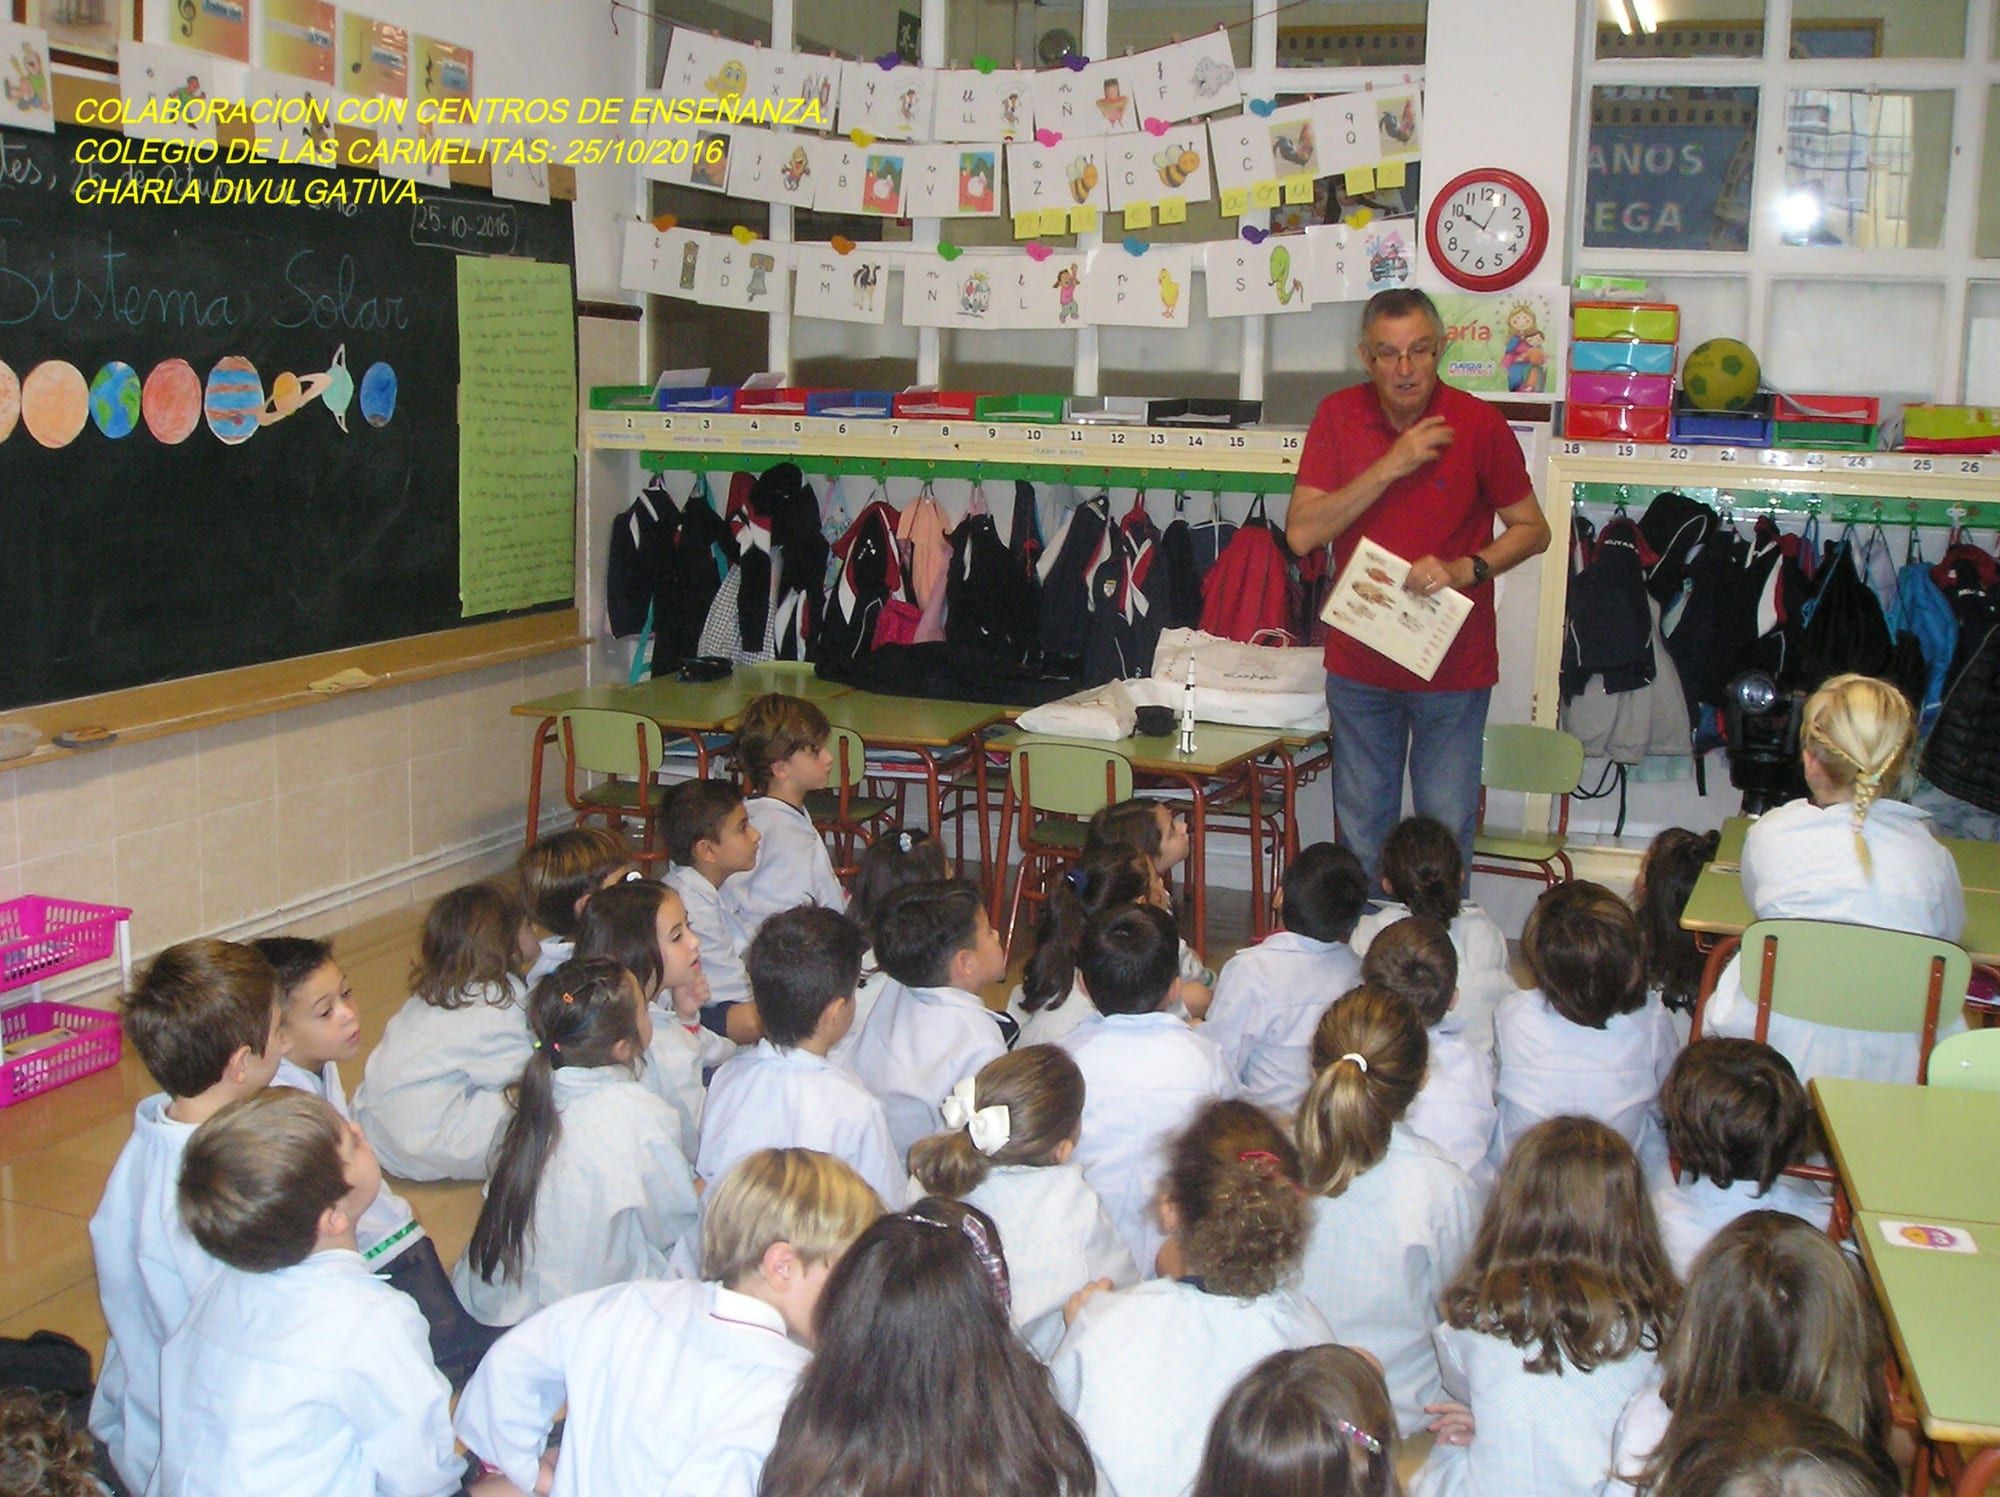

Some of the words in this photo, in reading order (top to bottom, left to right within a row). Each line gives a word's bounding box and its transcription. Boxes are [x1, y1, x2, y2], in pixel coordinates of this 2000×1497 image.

[772, 84, 780, 96] X
[1159, 86, 1168, 99] F
[1346, 130, 1358, 144] Q
[1243, 157, 1253, 172] C
[839, 175, 848, 187] B
[1125, 171, 1135, 185] C
[926, 185, 934, 196] V
[1033, 181, 1043, 195] Z
[1481, 188, 1494, 201] 12
[1466, 192, 1475, 205] 11
[1502, 193, 1507, 206] 1
[1452, 204, 1466, 218] 10
[1512, 208, 1521, 220] 2
[1585, 201, 1683, 233] EGA
[1444, 220, 1454, 232] 9
[1516, 225, 1525, 239] 3
[1447, 237, 1458, 251] 8
[1508, 243, 1517, 254] 4
[1460, 250, 1470, 262] 7
[1494, 253, 1504, 266] 5
[1336, 262, 1345, 274] R
[1475, 257, 1485, 270] 6
[720, 274, 730, 287] D
[1236, 278, 1245, 291] S
[271, 249, 409, 330] Solar
[820, 281, 831, 294] M
[927, 290, 937, 301] N
[1117, 292, 1125, 304] P
[1019, 297, 1028, 309] L
[1445, 319, 1491, 341] aría
[626, 418, 632, 428] 1
[664, 418, 672, 428] 2
[703, 419, 710, 429] 3
[750, 420, 758, 430] 4
[794, 422, 802, 432] 5
[838, 424, 846, 434] 6
[891, 425, 899, 435] 7
[941, 426, 950, 437] 8
[988, 427, 996, 439] 9
[1026, 429, 1041, 440] 10
[1070, 430, 1083, 441] 11
[1111, 433, 1125, 444] 12
[1150, 433, 1165, 445] 13
[1188, 435, 1203, 447] 14
[1229, 437, 1244, 448] 15
[1282, 437, 1298, 448] 16
[1564, 443, 1580, 455] 18
[1617, 444, 1634, 457] 19
[1669, 448, 1688, 460] 20
[1914, 459, 1932, 471] 25
[1961, 462, 1979, 473] 26
